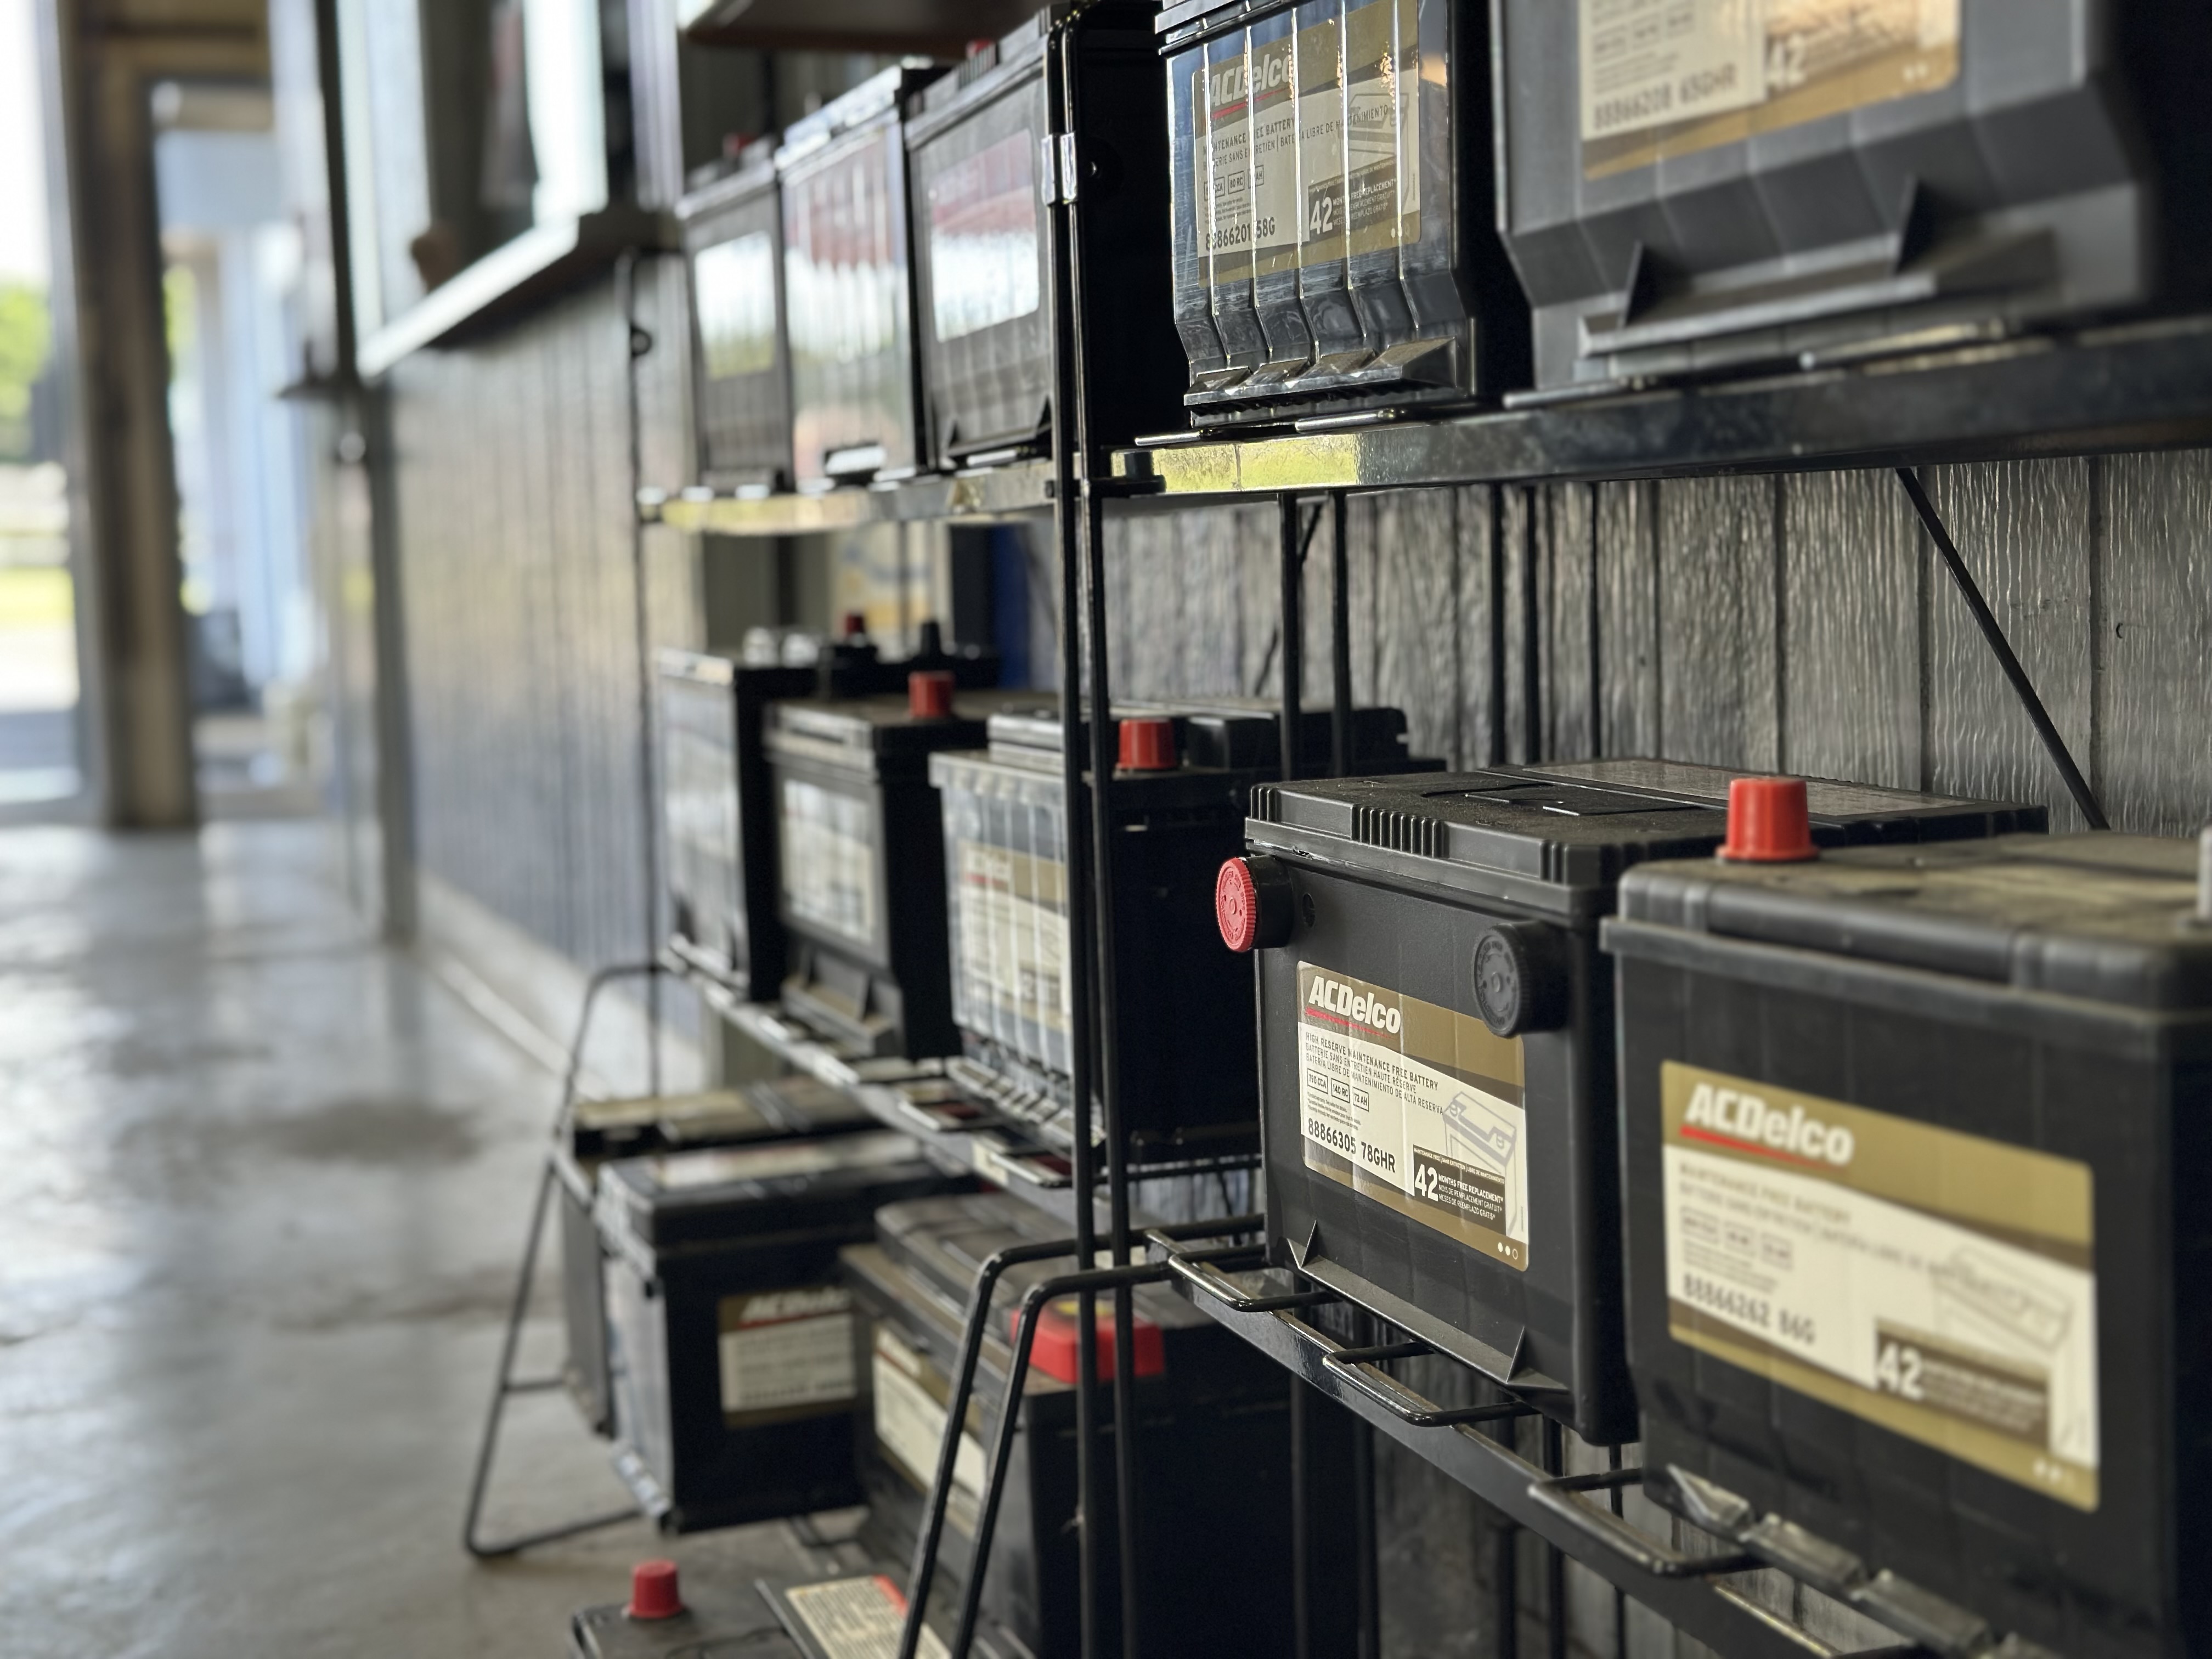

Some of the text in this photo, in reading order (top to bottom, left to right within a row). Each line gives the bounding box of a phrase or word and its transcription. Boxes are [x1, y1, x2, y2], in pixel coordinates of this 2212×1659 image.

[1768, 33, 1808, 91] 42
[1229, 150, 1243, 163] SANS
[1245, 139, 1274, 159] ERETIEN
[1306, 125, 1323, 139] LIBRE
[1325, 121, 1333, 133] DE
[1230, 178, 1236, 189] 80
[1256, 217, 1275, 239] 58G
[1310, 196, 1333, 235] 42
[1308, 975, 1401, 1034] ACDelco
[1306, 1032, 1438, 1091] HIGH RESERVE MAINTENANCE FREE BATTERY
[1306, 1042, 1328, 1059] BATTERIE
[1330, 1052, 1342, 1065] SANS
[1344, 1057, 1372, 1077] ENTRETIEN
[1374, 1069, 1391, 1084] HAUTE
[1317, 1077, 1327, 1089] CCA
[1327, 1062, 1341, 1075] LIBRE
[1343, 1066, 1350, 1077] DE
[1351, 1071, 1393, 1096] MANTENIMIENTO
[1395, 1088, 1402, 1099] DE
[1404, 1091, 1417, 1105] ALTA
[1418, 1097, 1443, 1115] RESERVA
[1342, 1087, 1348, 1097] RC
[1354, 1092, 1368, 1106] 72 AH
[1684, 1082, 1855, 1166] ACDelco
[1308, 1118, 1396, 1173] 88866305 78GHR
[1414, 1164, 1438, 1202] 42
[1438, 1173, 1457, 1188] MONTHS
[1457, 1181, 1468, 1192] FREE
[1438, 1184, 1448, 1194] MOIS
[1448, 1187, 1453, 1196] DE
[1454, 1189, 1483, 1207] REMPLACEMENT
[1438, 1193, 1451, 1204] MESES
[1451, 1198, 1457, 1206] DE
[1457, 1200, 1480, 1215] REEMPLAZO
[1683, 1271, 1815, 1347] 88866262 86G
[1876, 1341, 1925, 1401] 42
